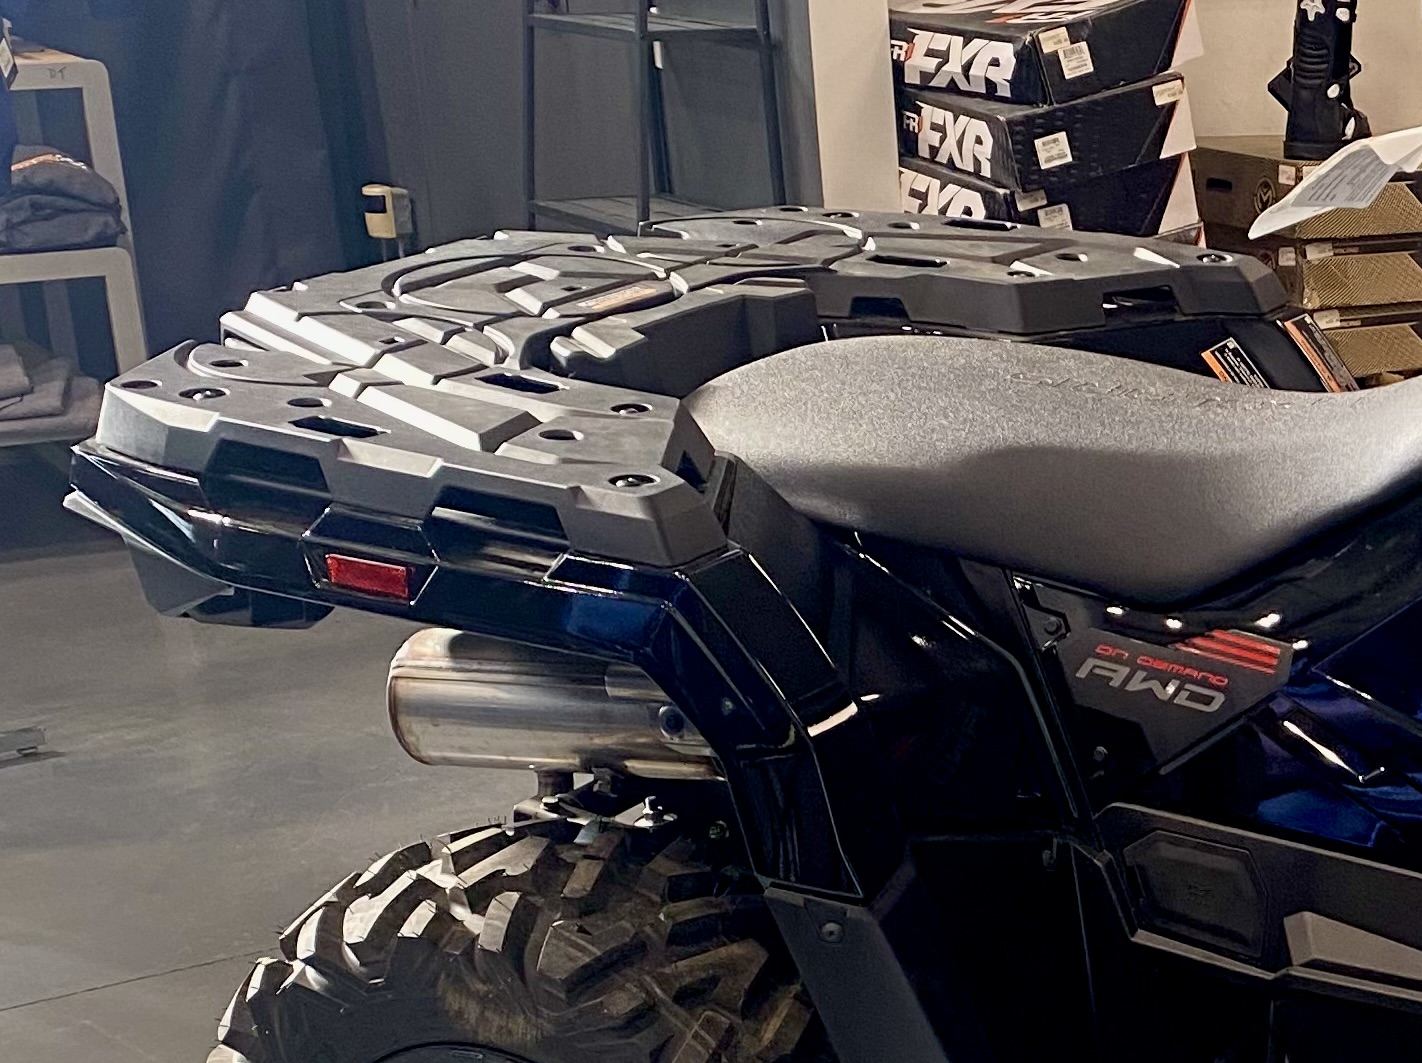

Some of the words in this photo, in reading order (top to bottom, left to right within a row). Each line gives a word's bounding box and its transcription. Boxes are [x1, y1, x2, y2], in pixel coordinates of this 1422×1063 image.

[904, 28, 1017, 98] FXR
[915, 90, 993, 179] FXR
[1075, 656, 1226, 713] AWD
